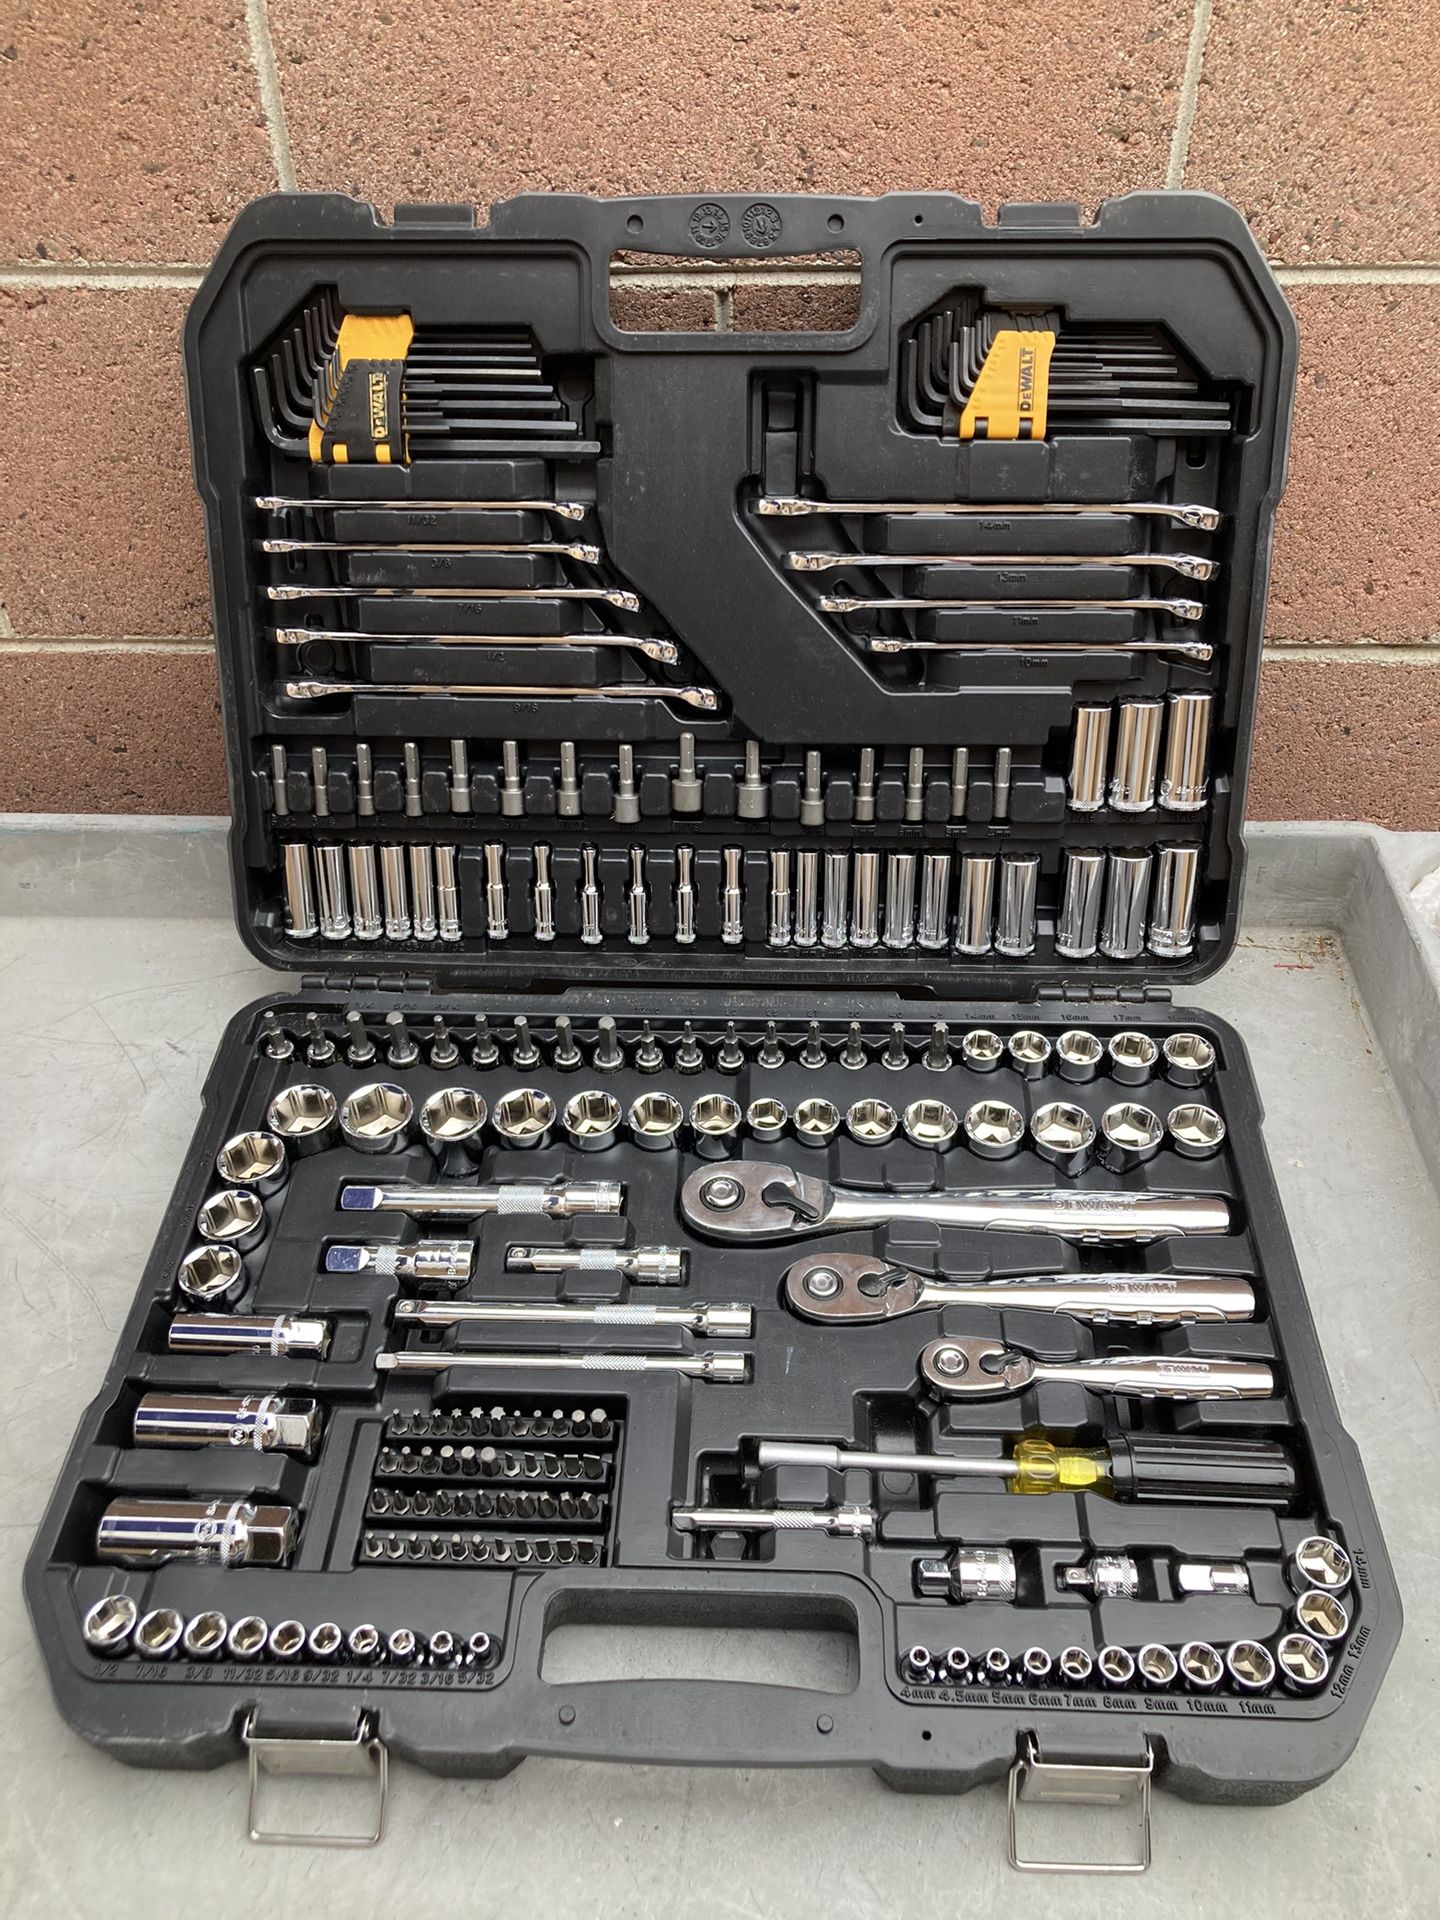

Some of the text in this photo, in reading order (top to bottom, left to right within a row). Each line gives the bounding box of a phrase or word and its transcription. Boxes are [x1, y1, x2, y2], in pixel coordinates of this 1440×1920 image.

[1019, 347, 1034, 412] DEWALT
[371, 372, 387, 438] DEWALT
[1053, 1198, 1136, 1212] DEWALT
[1108, 1280, 1178, 1294] DEWALT
[1347, 1624, 1372, 1660] 13mm
[93, 1663, 120, 1678] 1/2
[135, 1664, 168, 1680] 7/16
[184, 1666, 214, 1681] 3/8
[223, 1667, 263, 1682] 11/32
[264, 1668, 299, 1683] 5/16
[347, 1669, 374, 1684] 1/4
[381, 1670, 416, 1685] 7/32
[419, 1671, 454, 1686] 3/16
[457, 1671, 495, 1687] 5/32
[1330, 1663, 1355, 1700] 12mm
[899, 1685, 1277, 1716] 4mm 4.5mm 5mm 6mm 7mm 8mm 9mm 10mm 11mm
